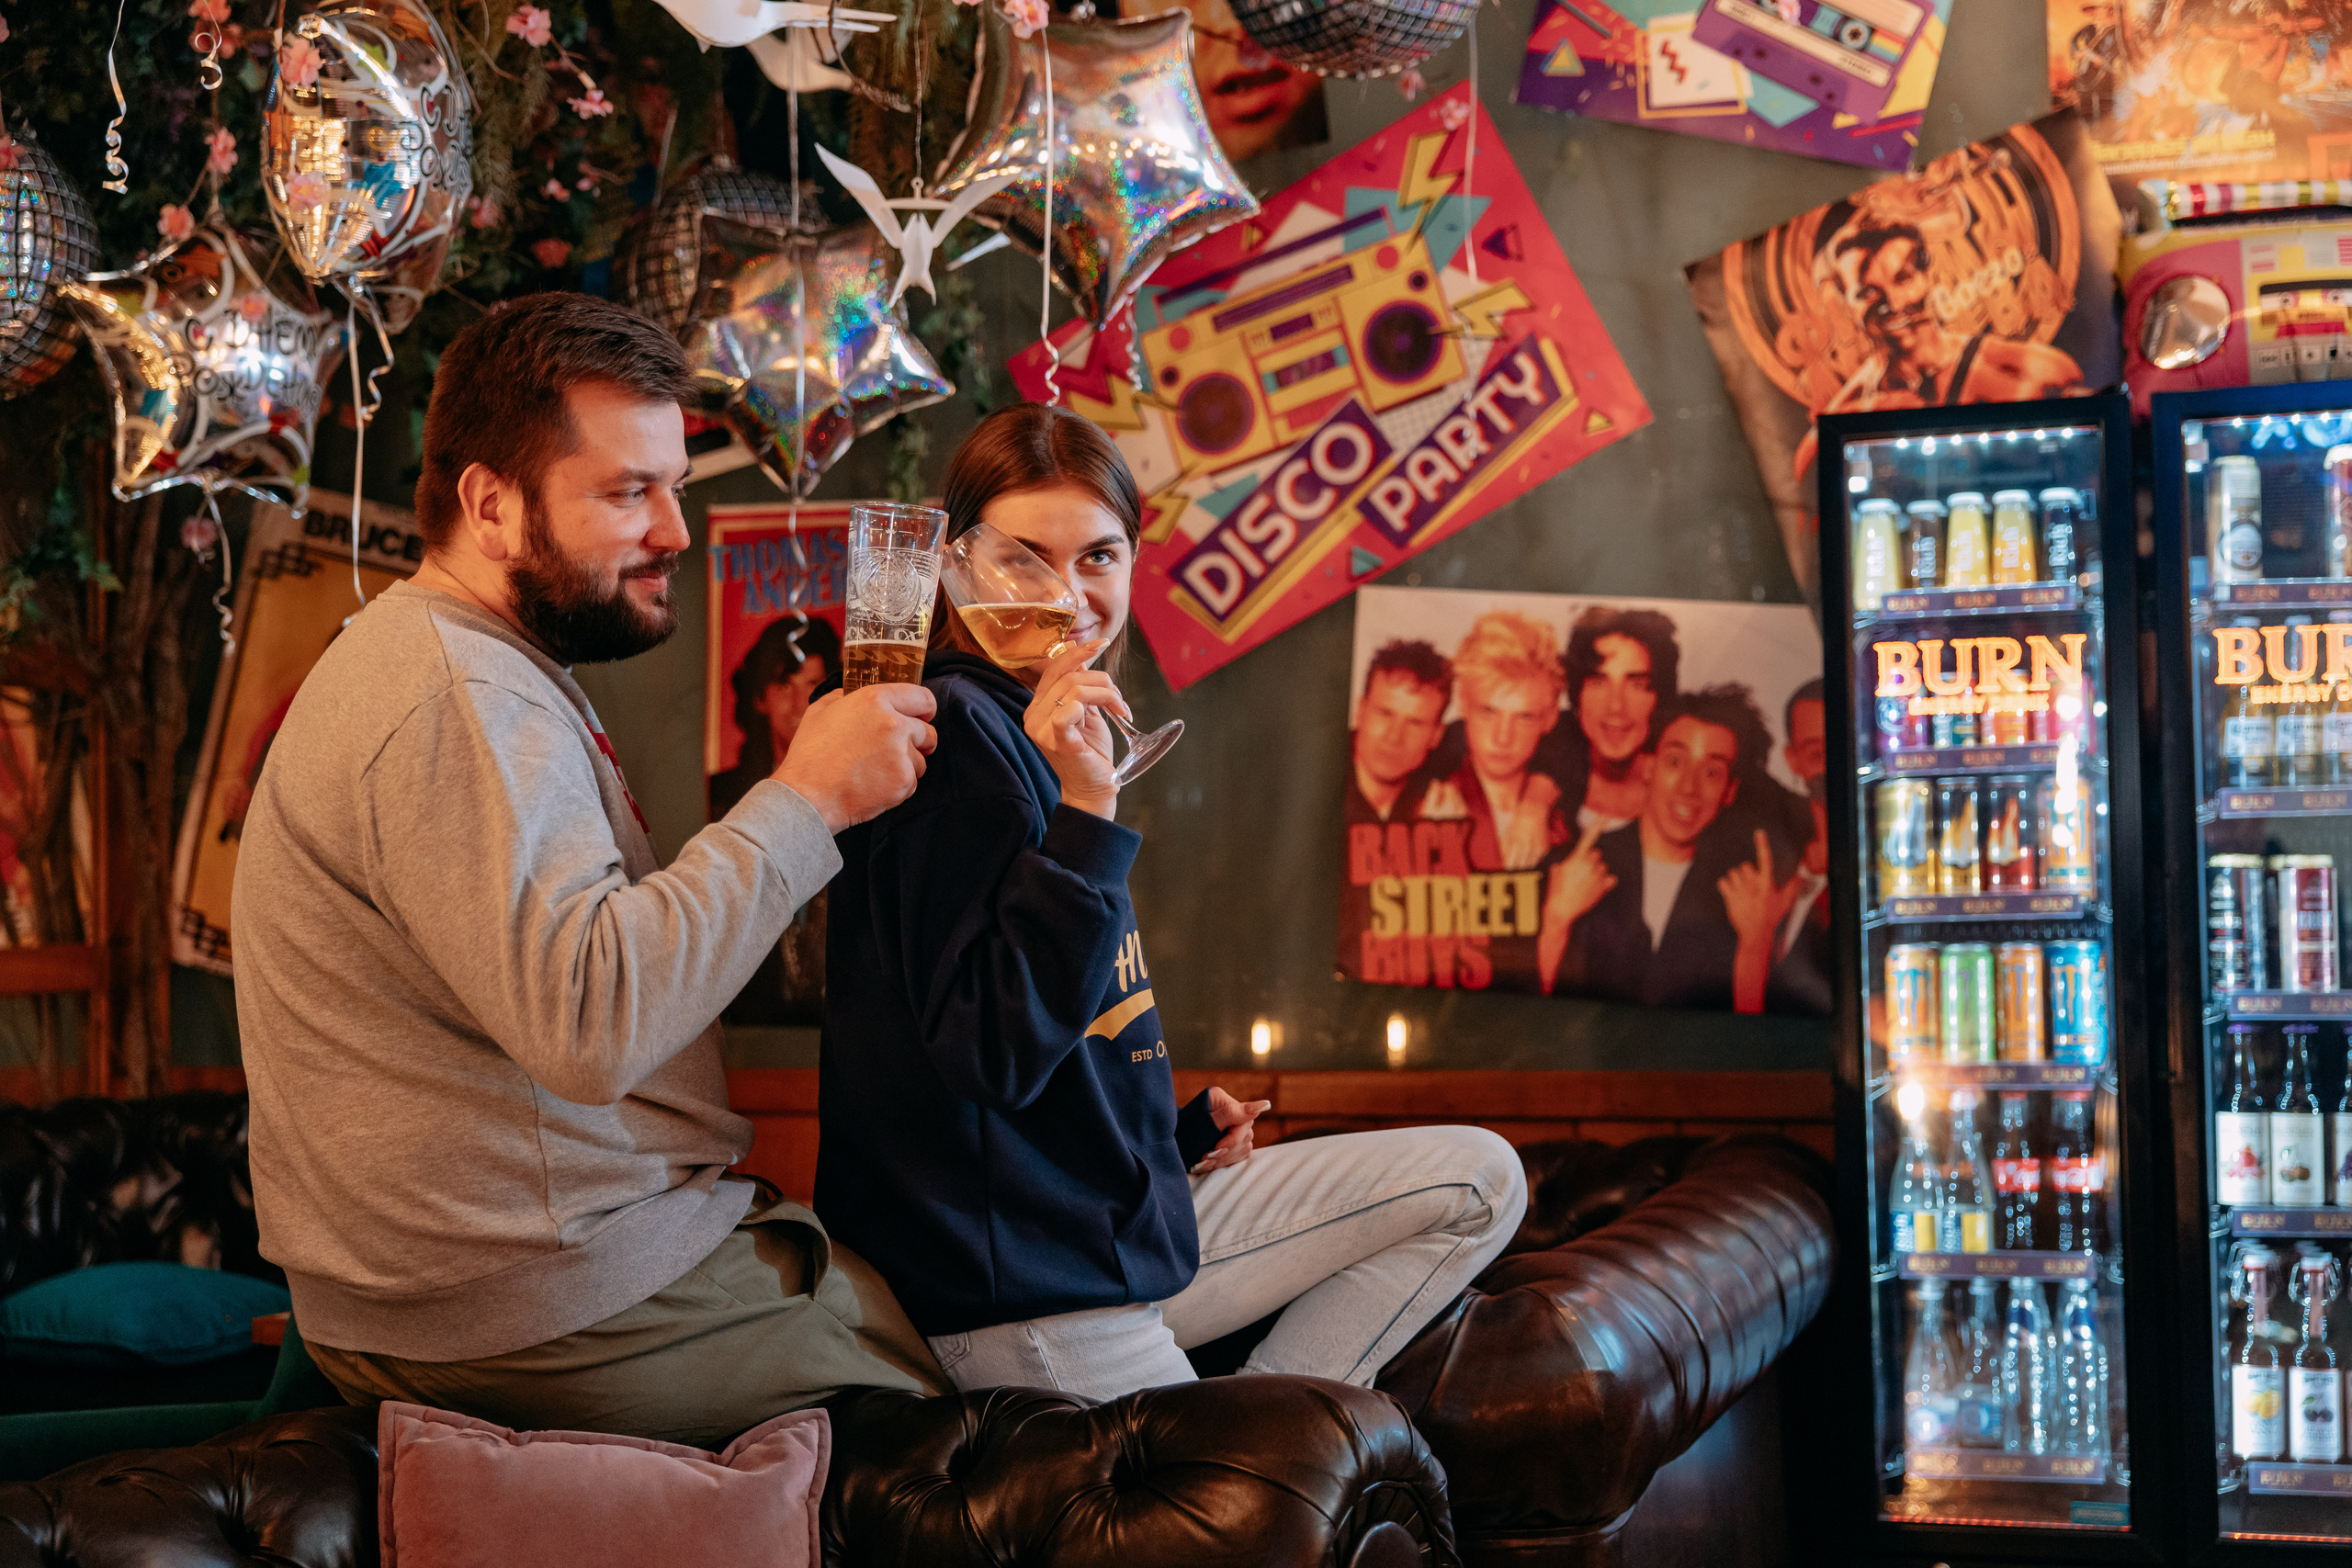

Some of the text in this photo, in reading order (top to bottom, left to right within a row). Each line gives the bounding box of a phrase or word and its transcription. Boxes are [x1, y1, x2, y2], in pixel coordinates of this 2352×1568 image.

[1367, 352, 1545, 532] PARTY
[1182, 421, 1374, 617] DISCO
[1872, 633, 2087, 697] BURN
[2250, 683, 2334, 705] ENERGY
[1370, 872, 1542, 940] STREET
[1132, 1049, 1152, 1062] ESTD
